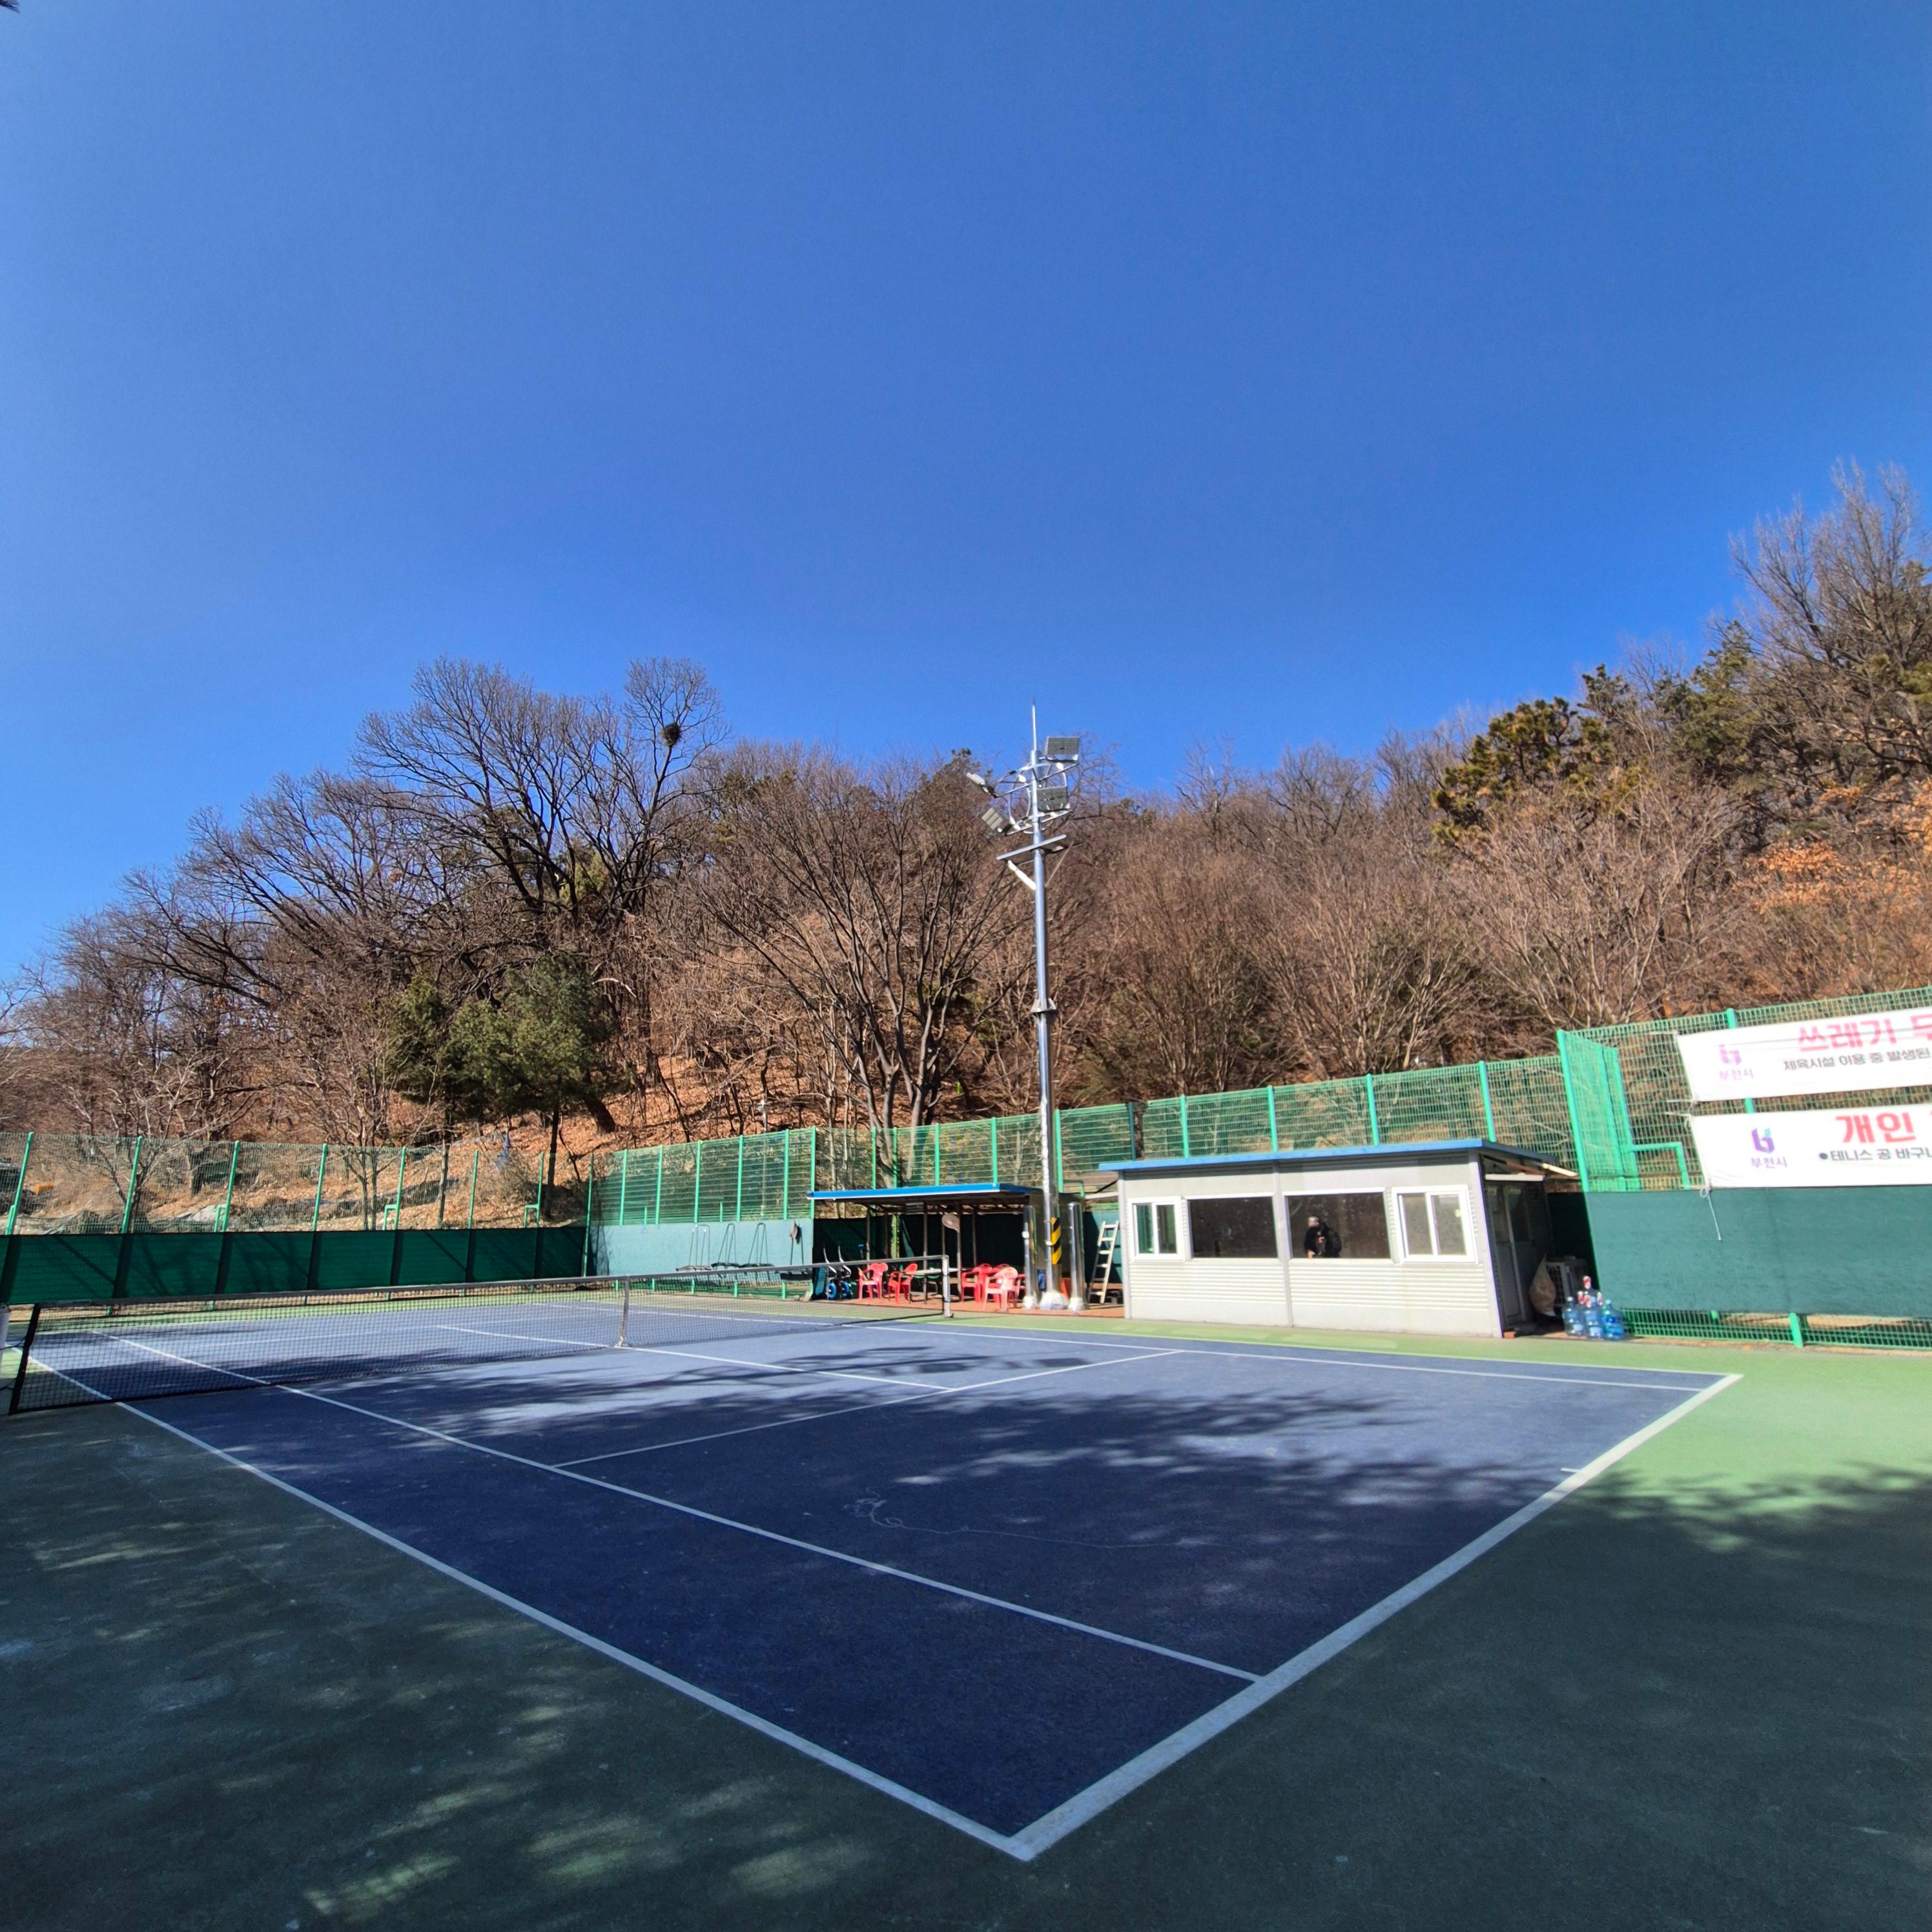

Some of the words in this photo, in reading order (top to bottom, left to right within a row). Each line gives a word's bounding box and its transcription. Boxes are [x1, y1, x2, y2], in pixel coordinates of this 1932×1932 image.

[1798, 1018, 1897, 1052] 쓰레기
[1783, 1056, 1835, 1071] 체육시설
[1839, 1053, 1866, 1065] 이용
[1886, 1047, 1931, 1062] 발생된
[1835, 1112, 1917, 1144] 개인
[1830, 1149, 1873, 1161] 테니스
[1876, 1148, 1891, 1160] 공
